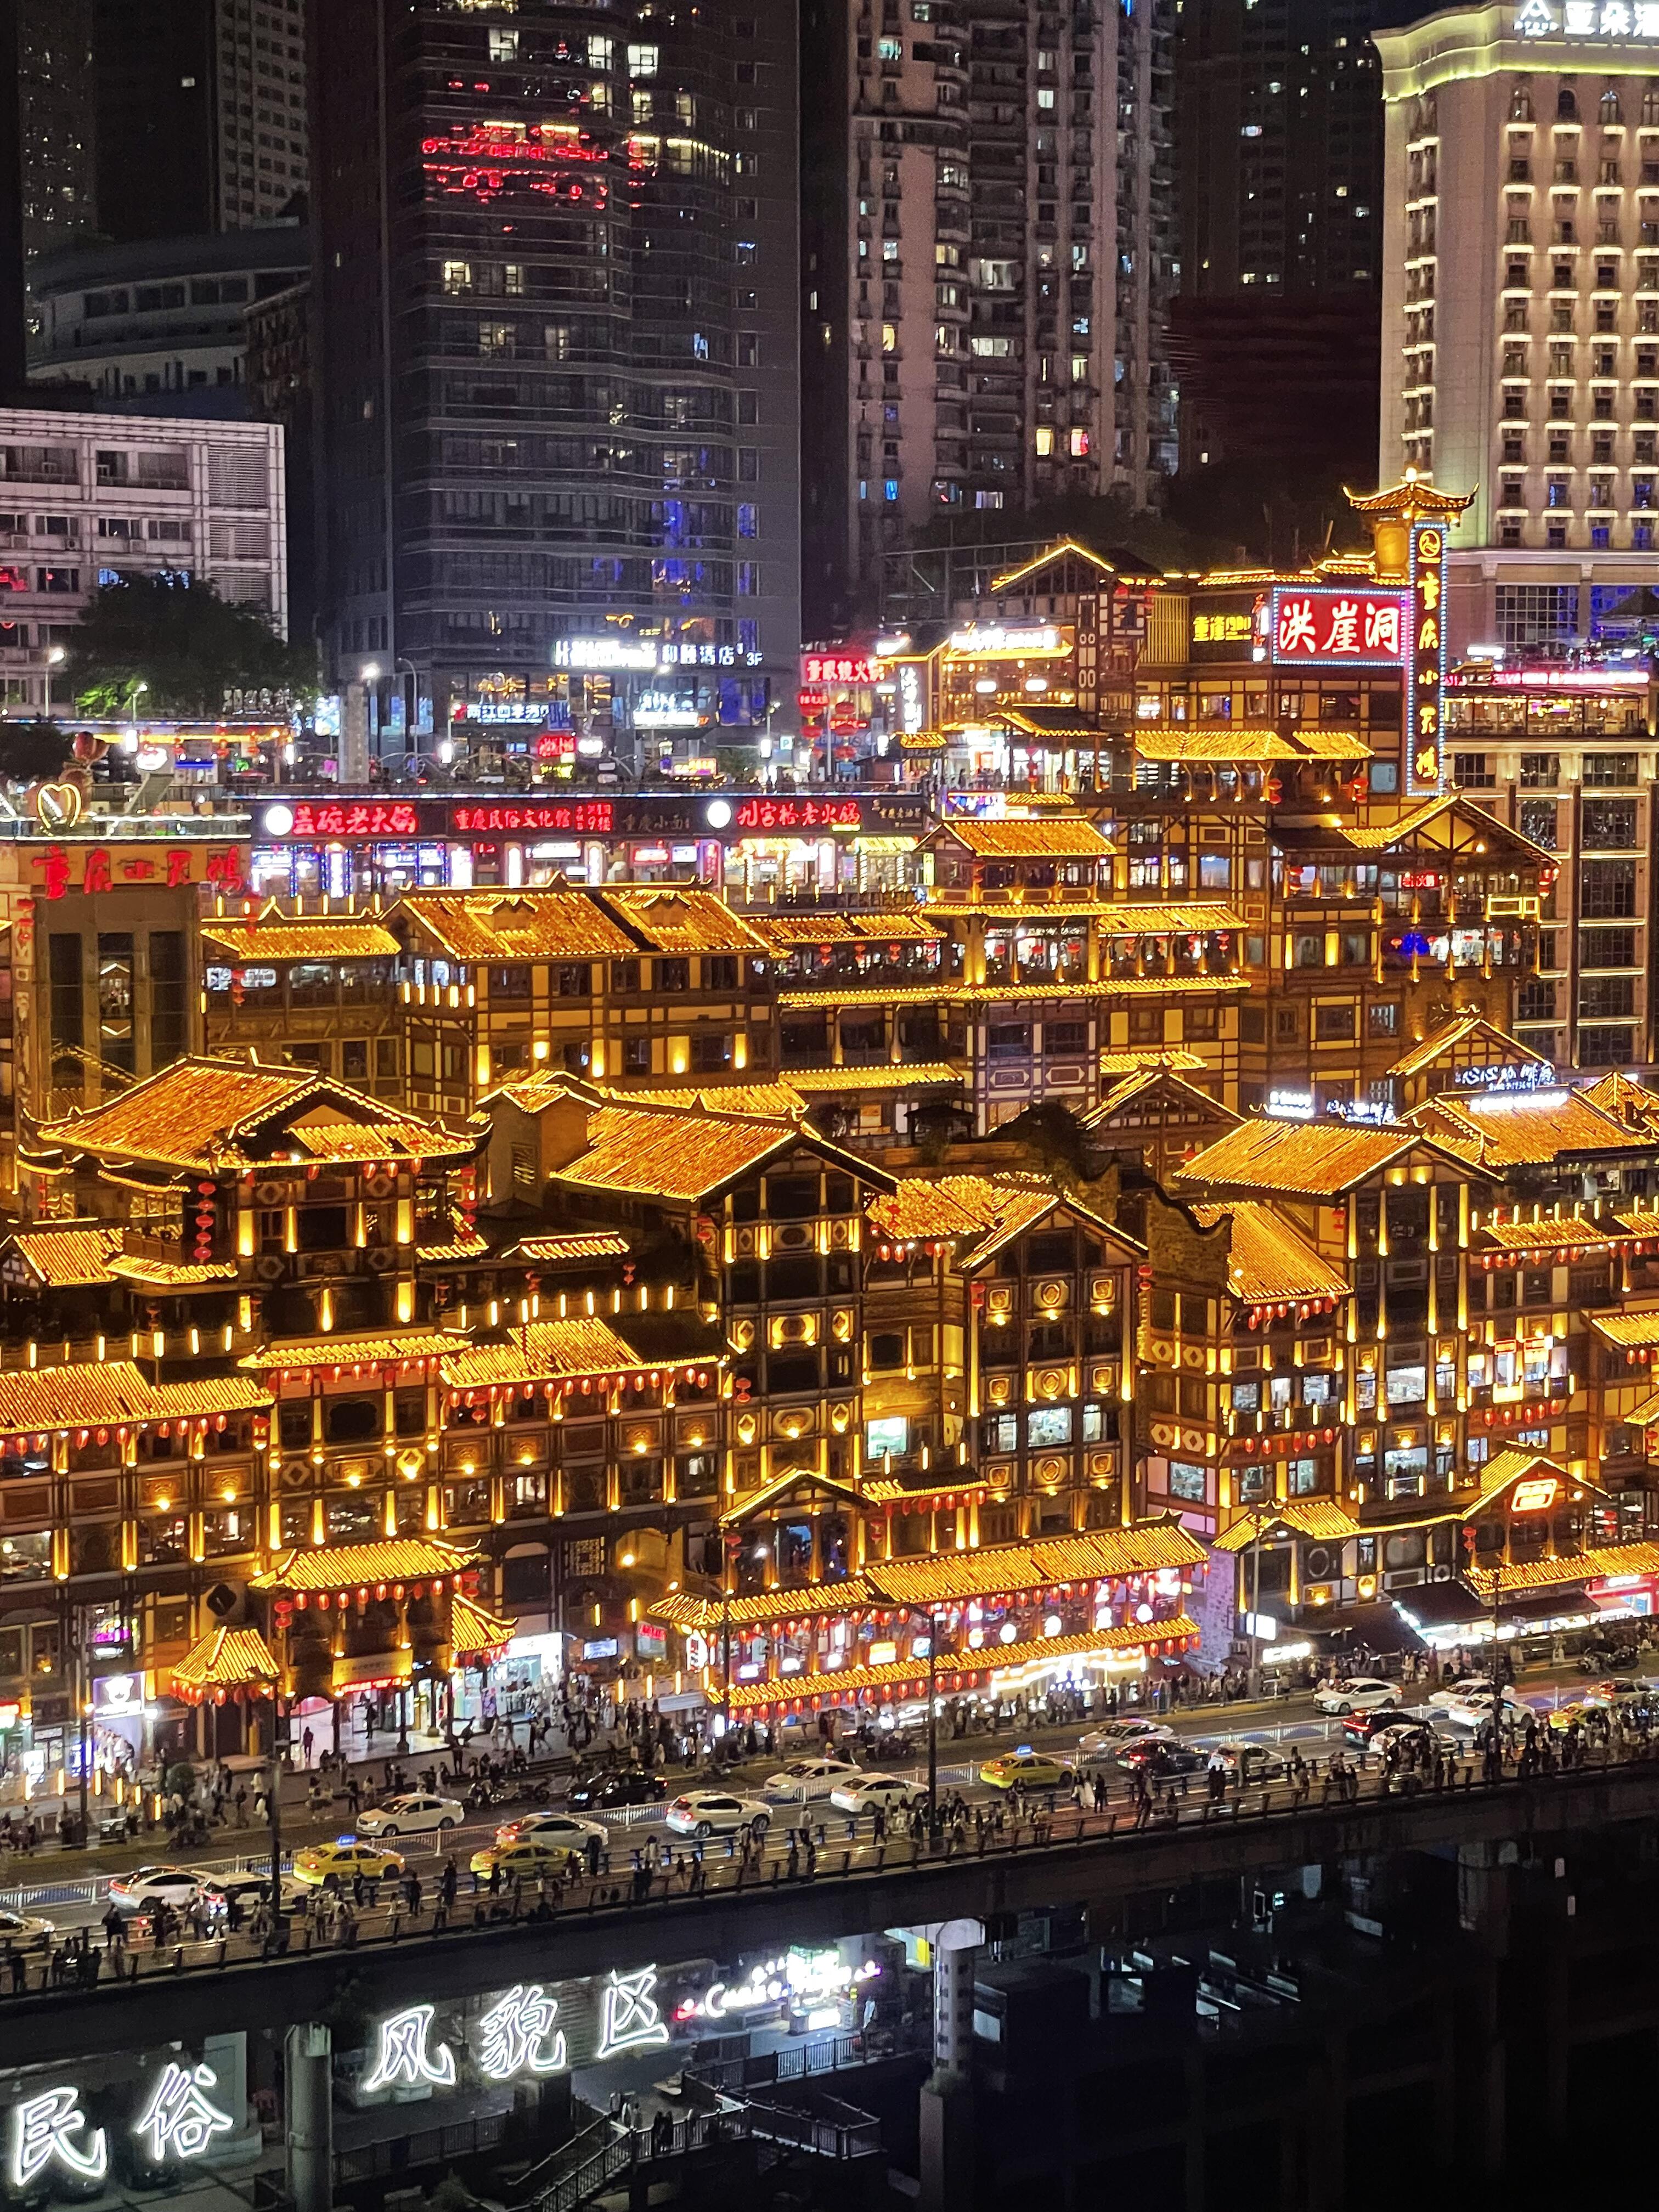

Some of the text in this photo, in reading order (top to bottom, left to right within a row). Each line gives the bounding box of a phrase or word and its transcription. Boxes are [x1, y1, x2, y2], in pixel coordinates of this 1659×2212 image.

[1280, 599, 1400, 654] 洪崖洞
[662, 644, 735, 665] 和颐酒店
[747, 651, 763, 666] 3F
[1417, 572, 1439, 780] 重庆小天鹅
[293, 805, 416, 833] 盖碗老火锅
[738, 801, 861, 827] 九宫格老火锅
[12, 1962, 670, 2186] 民俗风貌区
